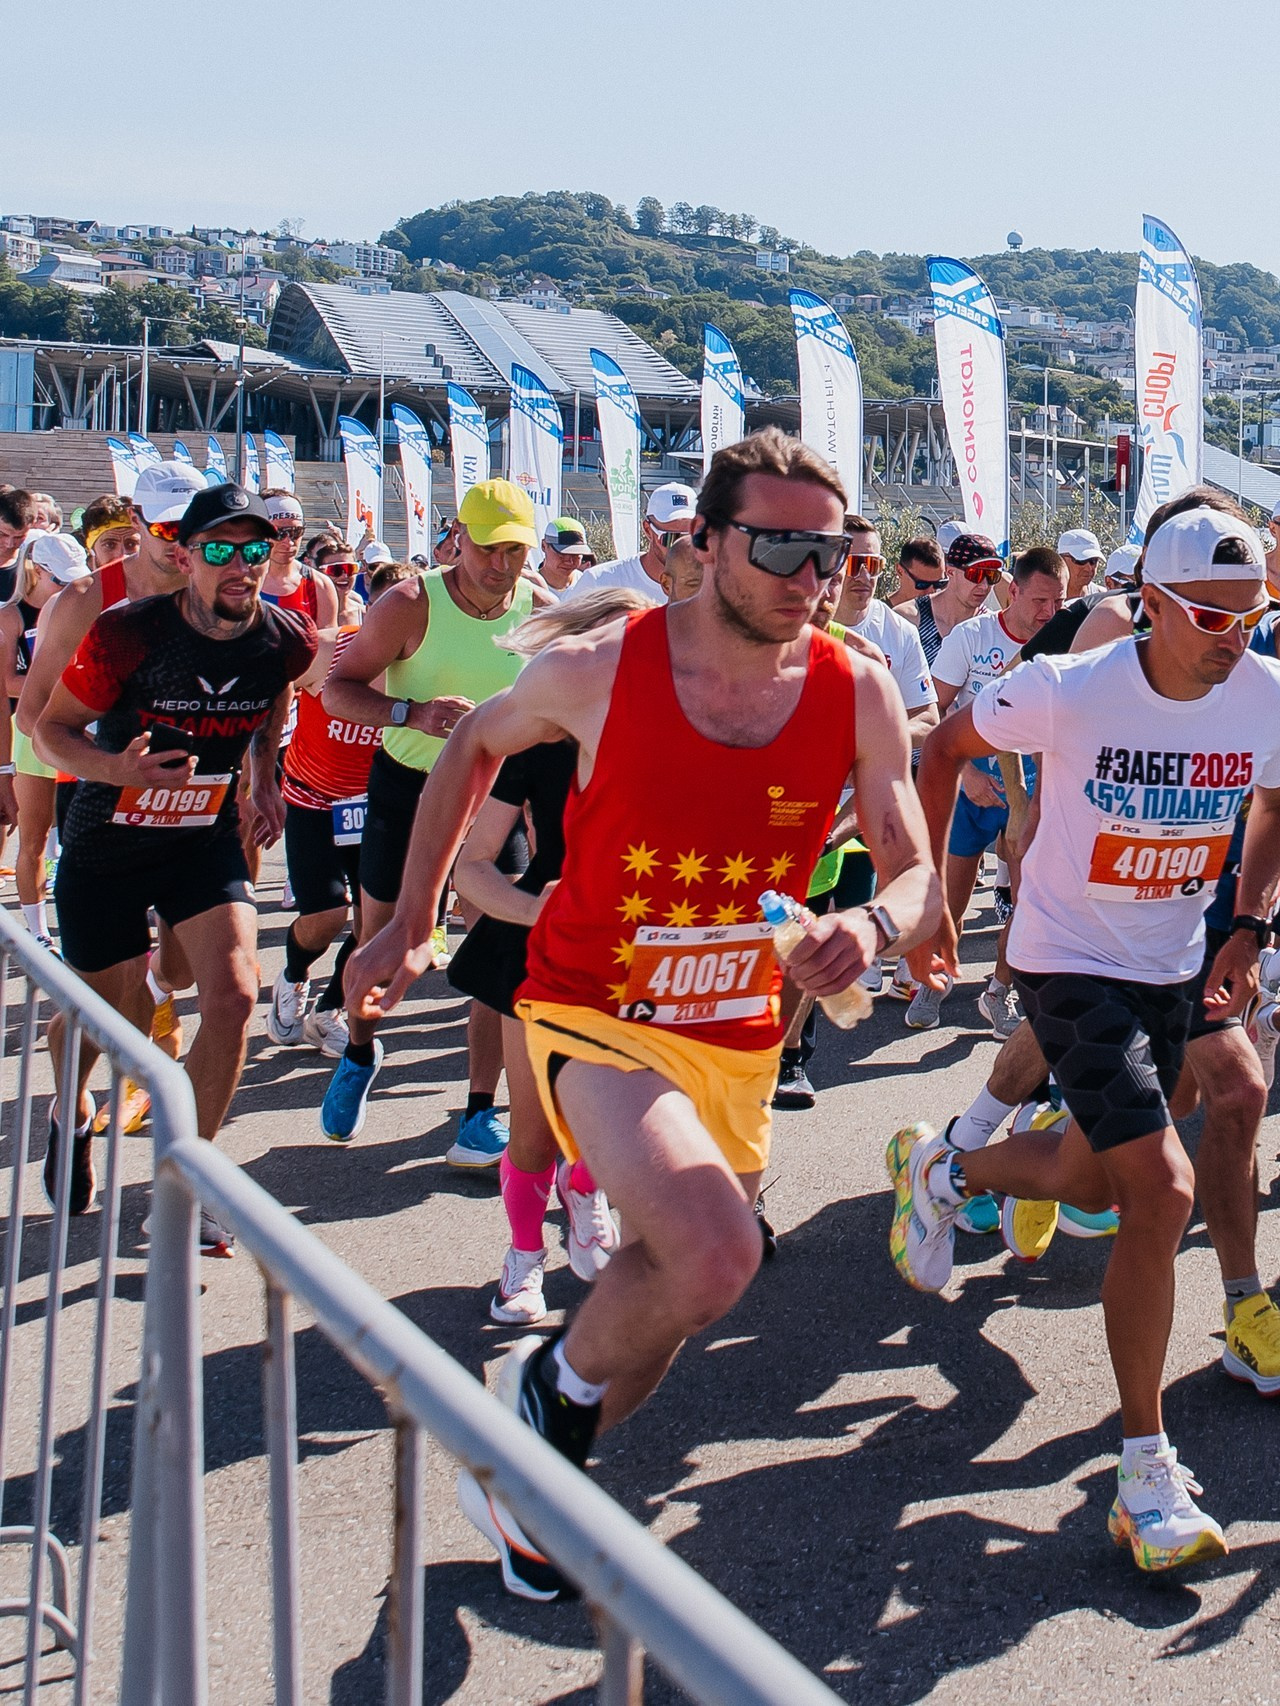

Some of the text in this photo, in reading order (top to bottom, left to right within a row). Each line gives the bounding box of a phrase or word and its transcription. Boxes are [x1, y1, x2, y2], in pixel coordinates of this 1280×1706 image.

[153, 699, 269, 711] HERO LEAGUE
[327, 719, 384, 747] RUSS
[1095, 746, 1253, 788] #ЗАБЕГ2025
[136, 787, 211, 812] 40199
[1112, 845, 1210, 880] 40190
[1183, 879, 1199, 892] A
[647, 949, 760, 997] 40057
[633, 1003, 653, 1020] A
